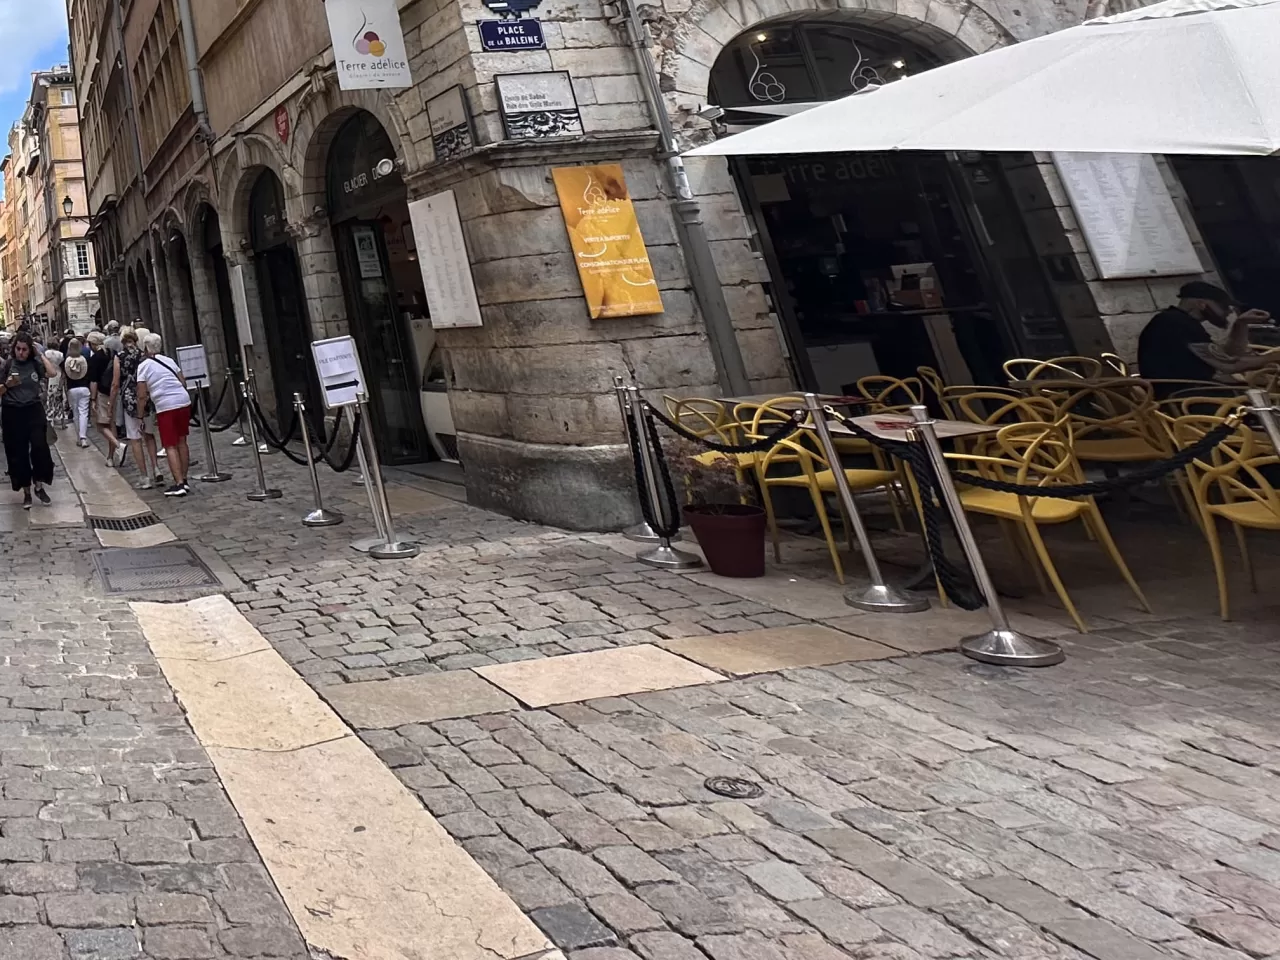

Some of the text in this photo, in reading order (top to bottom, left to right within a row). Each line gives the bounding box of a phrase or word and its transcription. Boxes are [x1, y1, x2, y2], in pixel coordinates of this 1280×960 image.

[497, 25, 525, 35] PLACE
[505, 35, 540, 45] BALEINE
[339, 60, 367, 72] Terre
[343, 172, 368, 193] GLACIER
[577, 207, 595, 216] Terre
